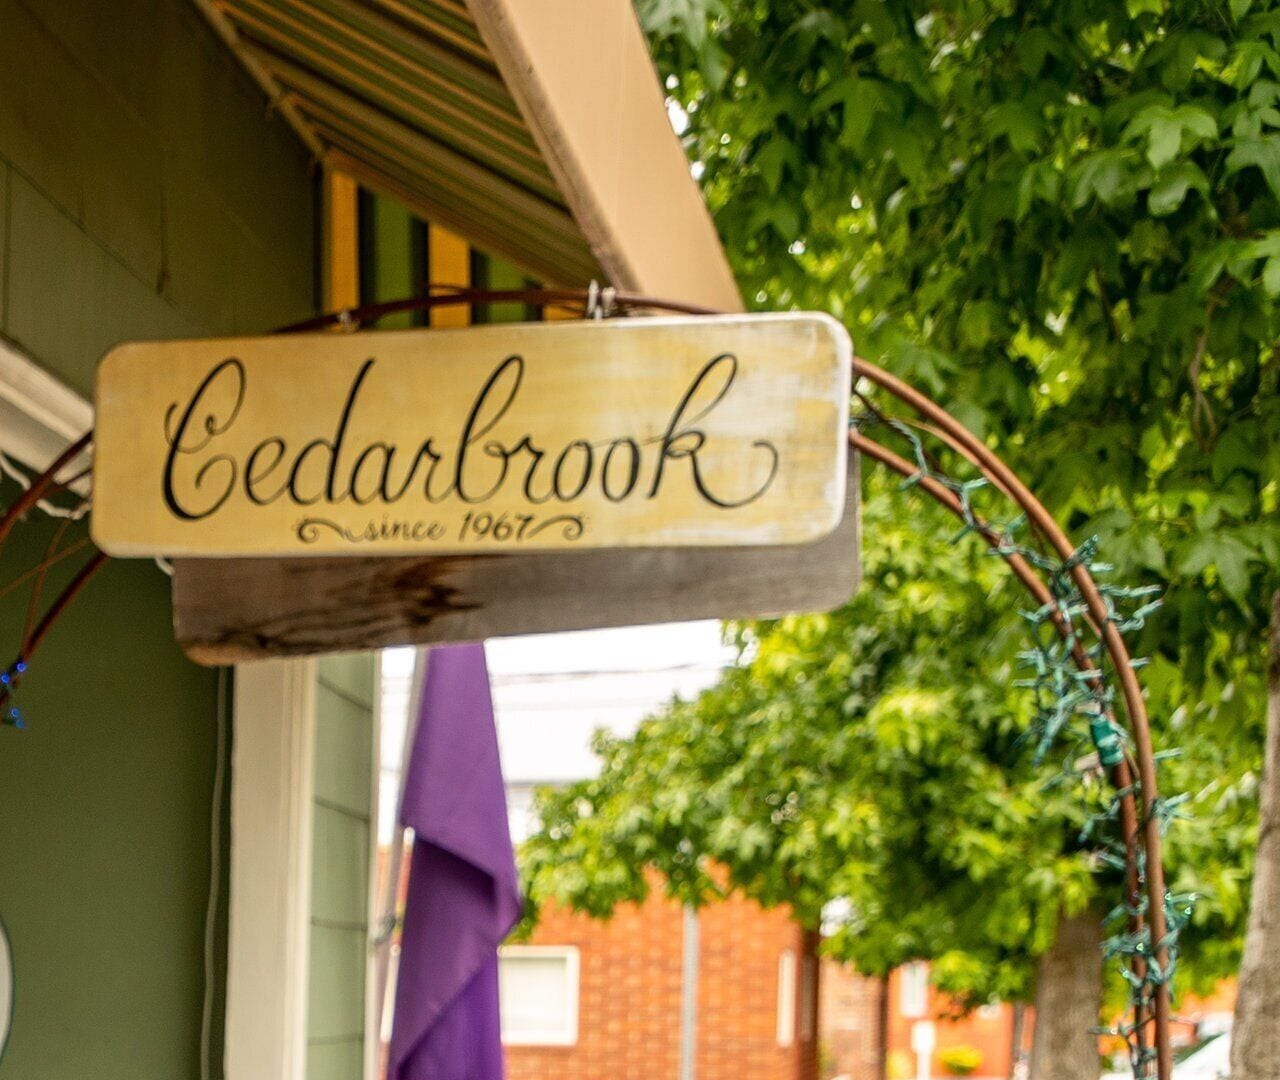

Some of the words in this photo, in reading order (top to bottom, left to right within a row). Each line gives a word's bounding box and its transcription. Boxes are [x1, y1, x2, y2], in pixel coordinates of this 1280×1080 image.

[161, 352, 780, 521] Cedarbrook
[360, 514, 446, 543] since
[458, 511, 535, 542] 1967
